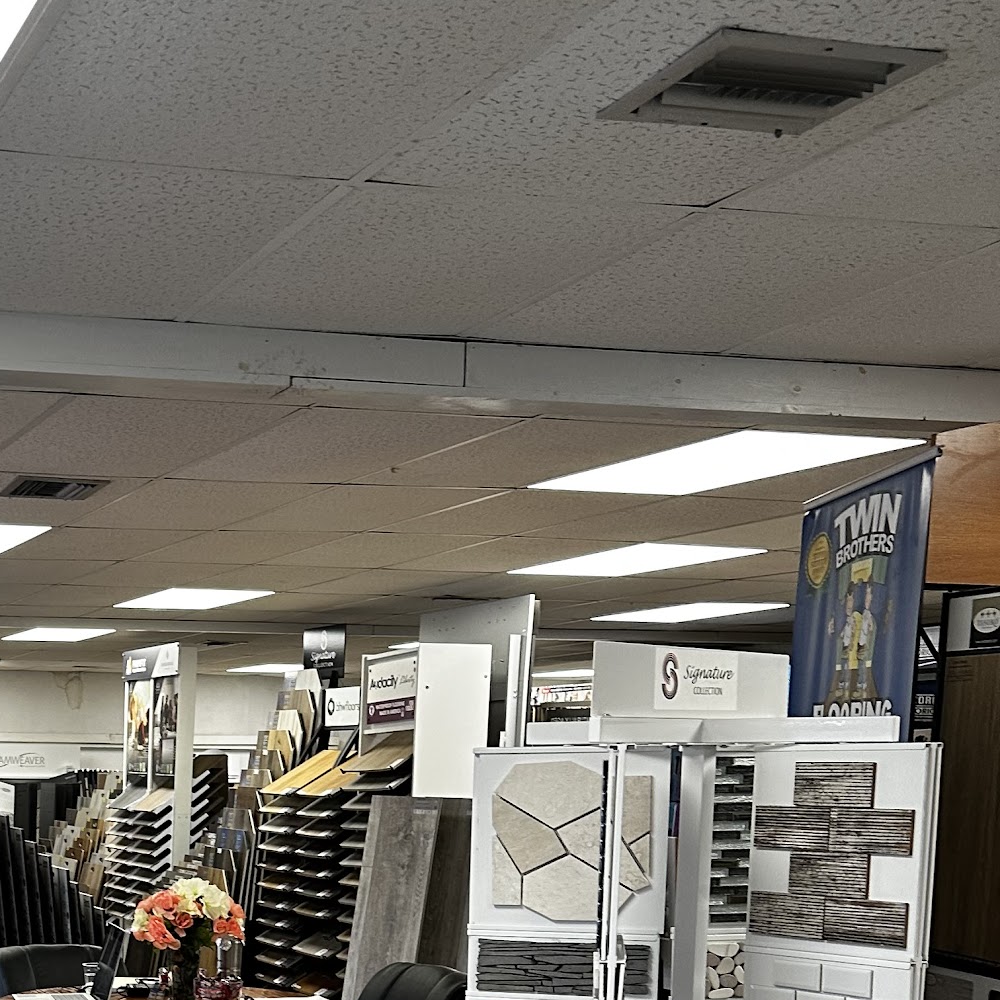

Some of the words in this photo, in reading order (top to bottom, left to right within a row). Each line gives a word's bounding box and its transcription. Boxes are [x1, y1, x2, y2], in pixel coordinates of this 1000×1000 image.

[834, 493, 902, 548] TWIN
[836, 534, 894, 569] BROTHERS
[683, 665, 734, 684] Signature
[693, 686, 722, 695] COLLECTION
